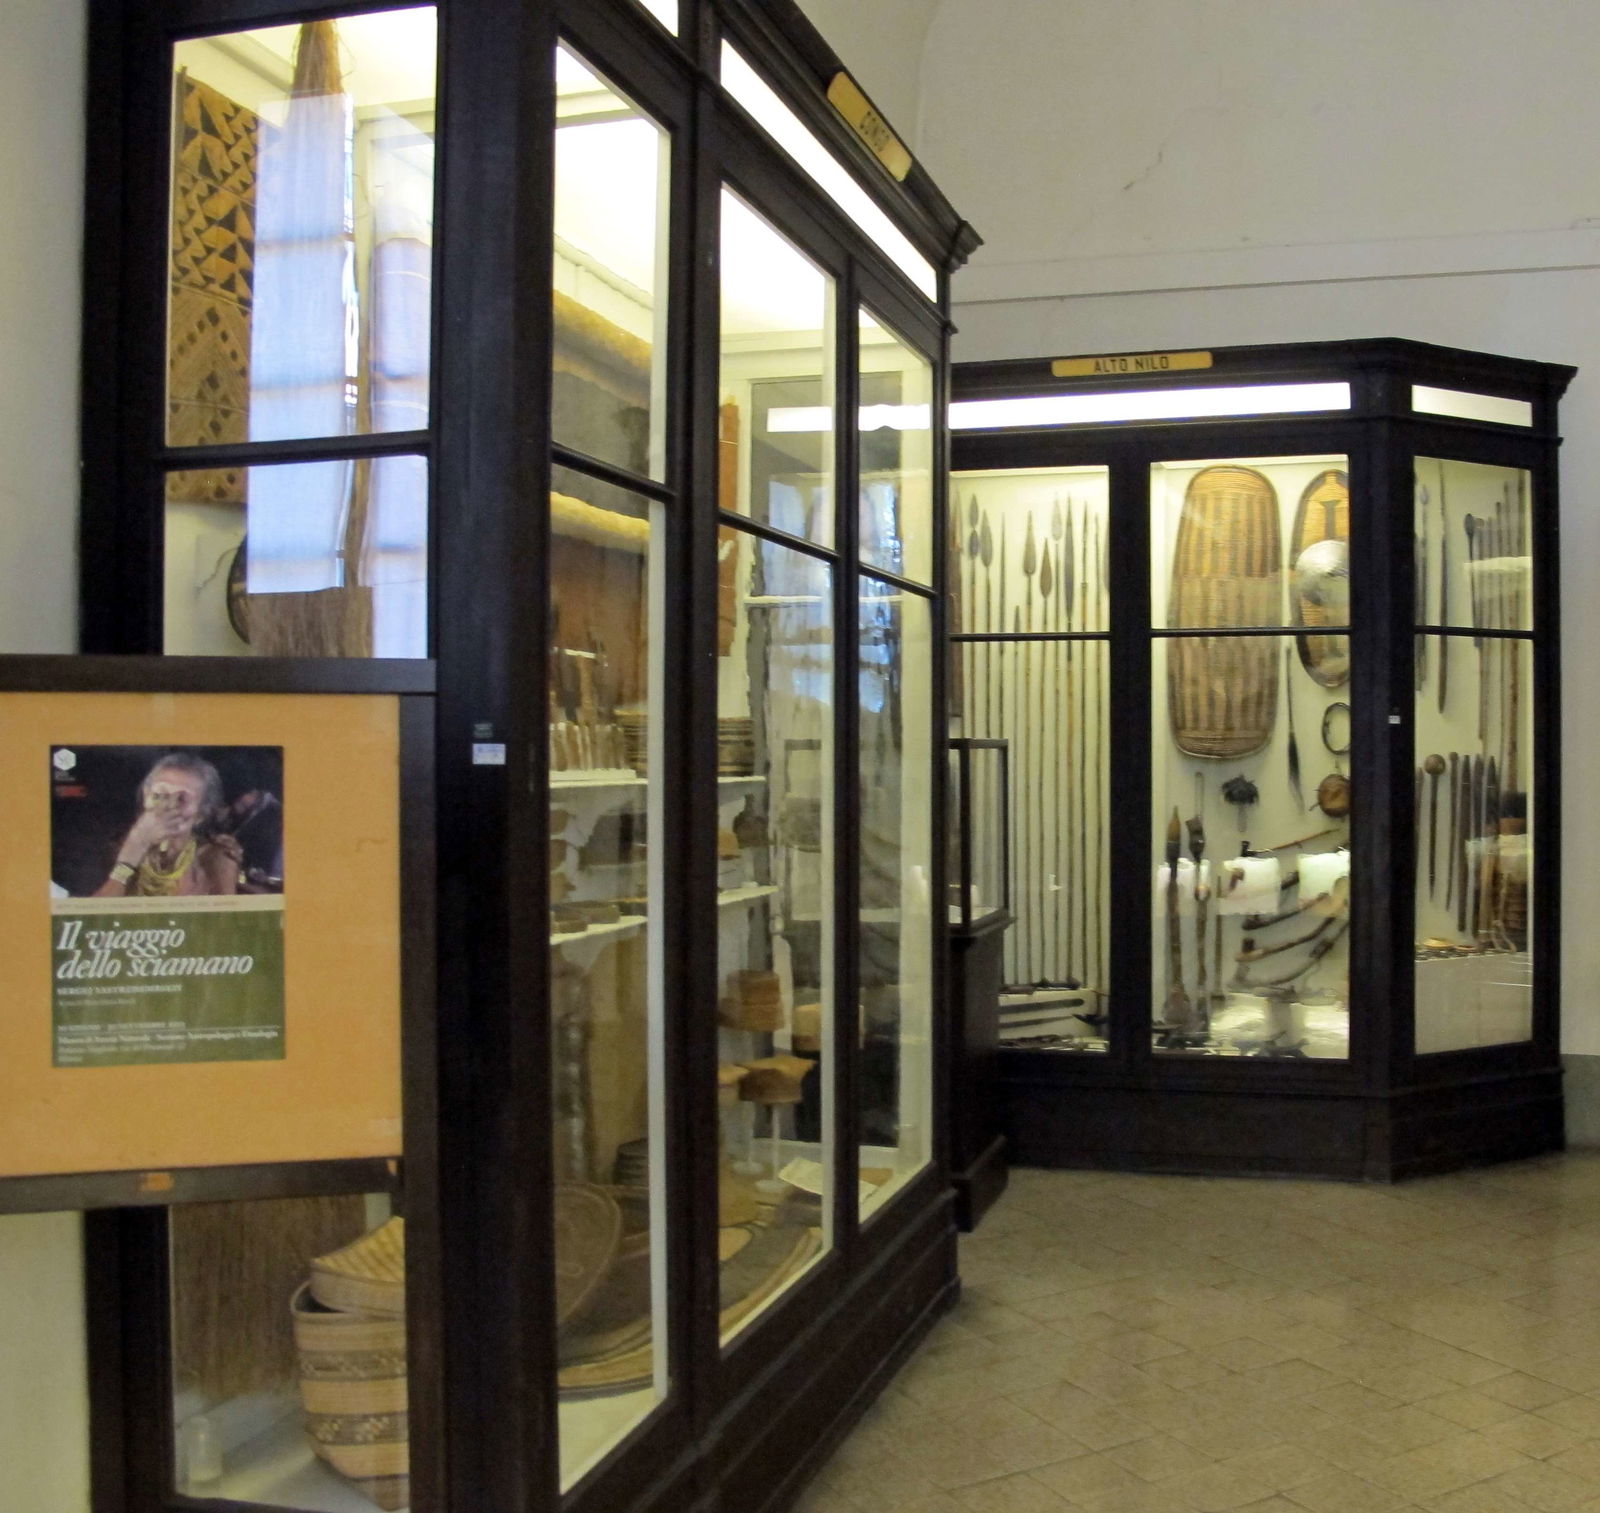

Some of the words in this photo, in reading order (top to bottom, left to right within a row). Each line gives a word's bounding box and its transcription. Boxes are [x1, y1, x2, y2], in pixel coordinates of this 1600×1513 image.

[1093, 359, 1128, 374] ALTO
[1134, 356, 1170, 370] NILO
[56, 920, 83, 950] Il
[86, 920, 186, 958] viaggio
[56, 950, 122, 979] dello
[126, 949, 254, 977] sciamano
